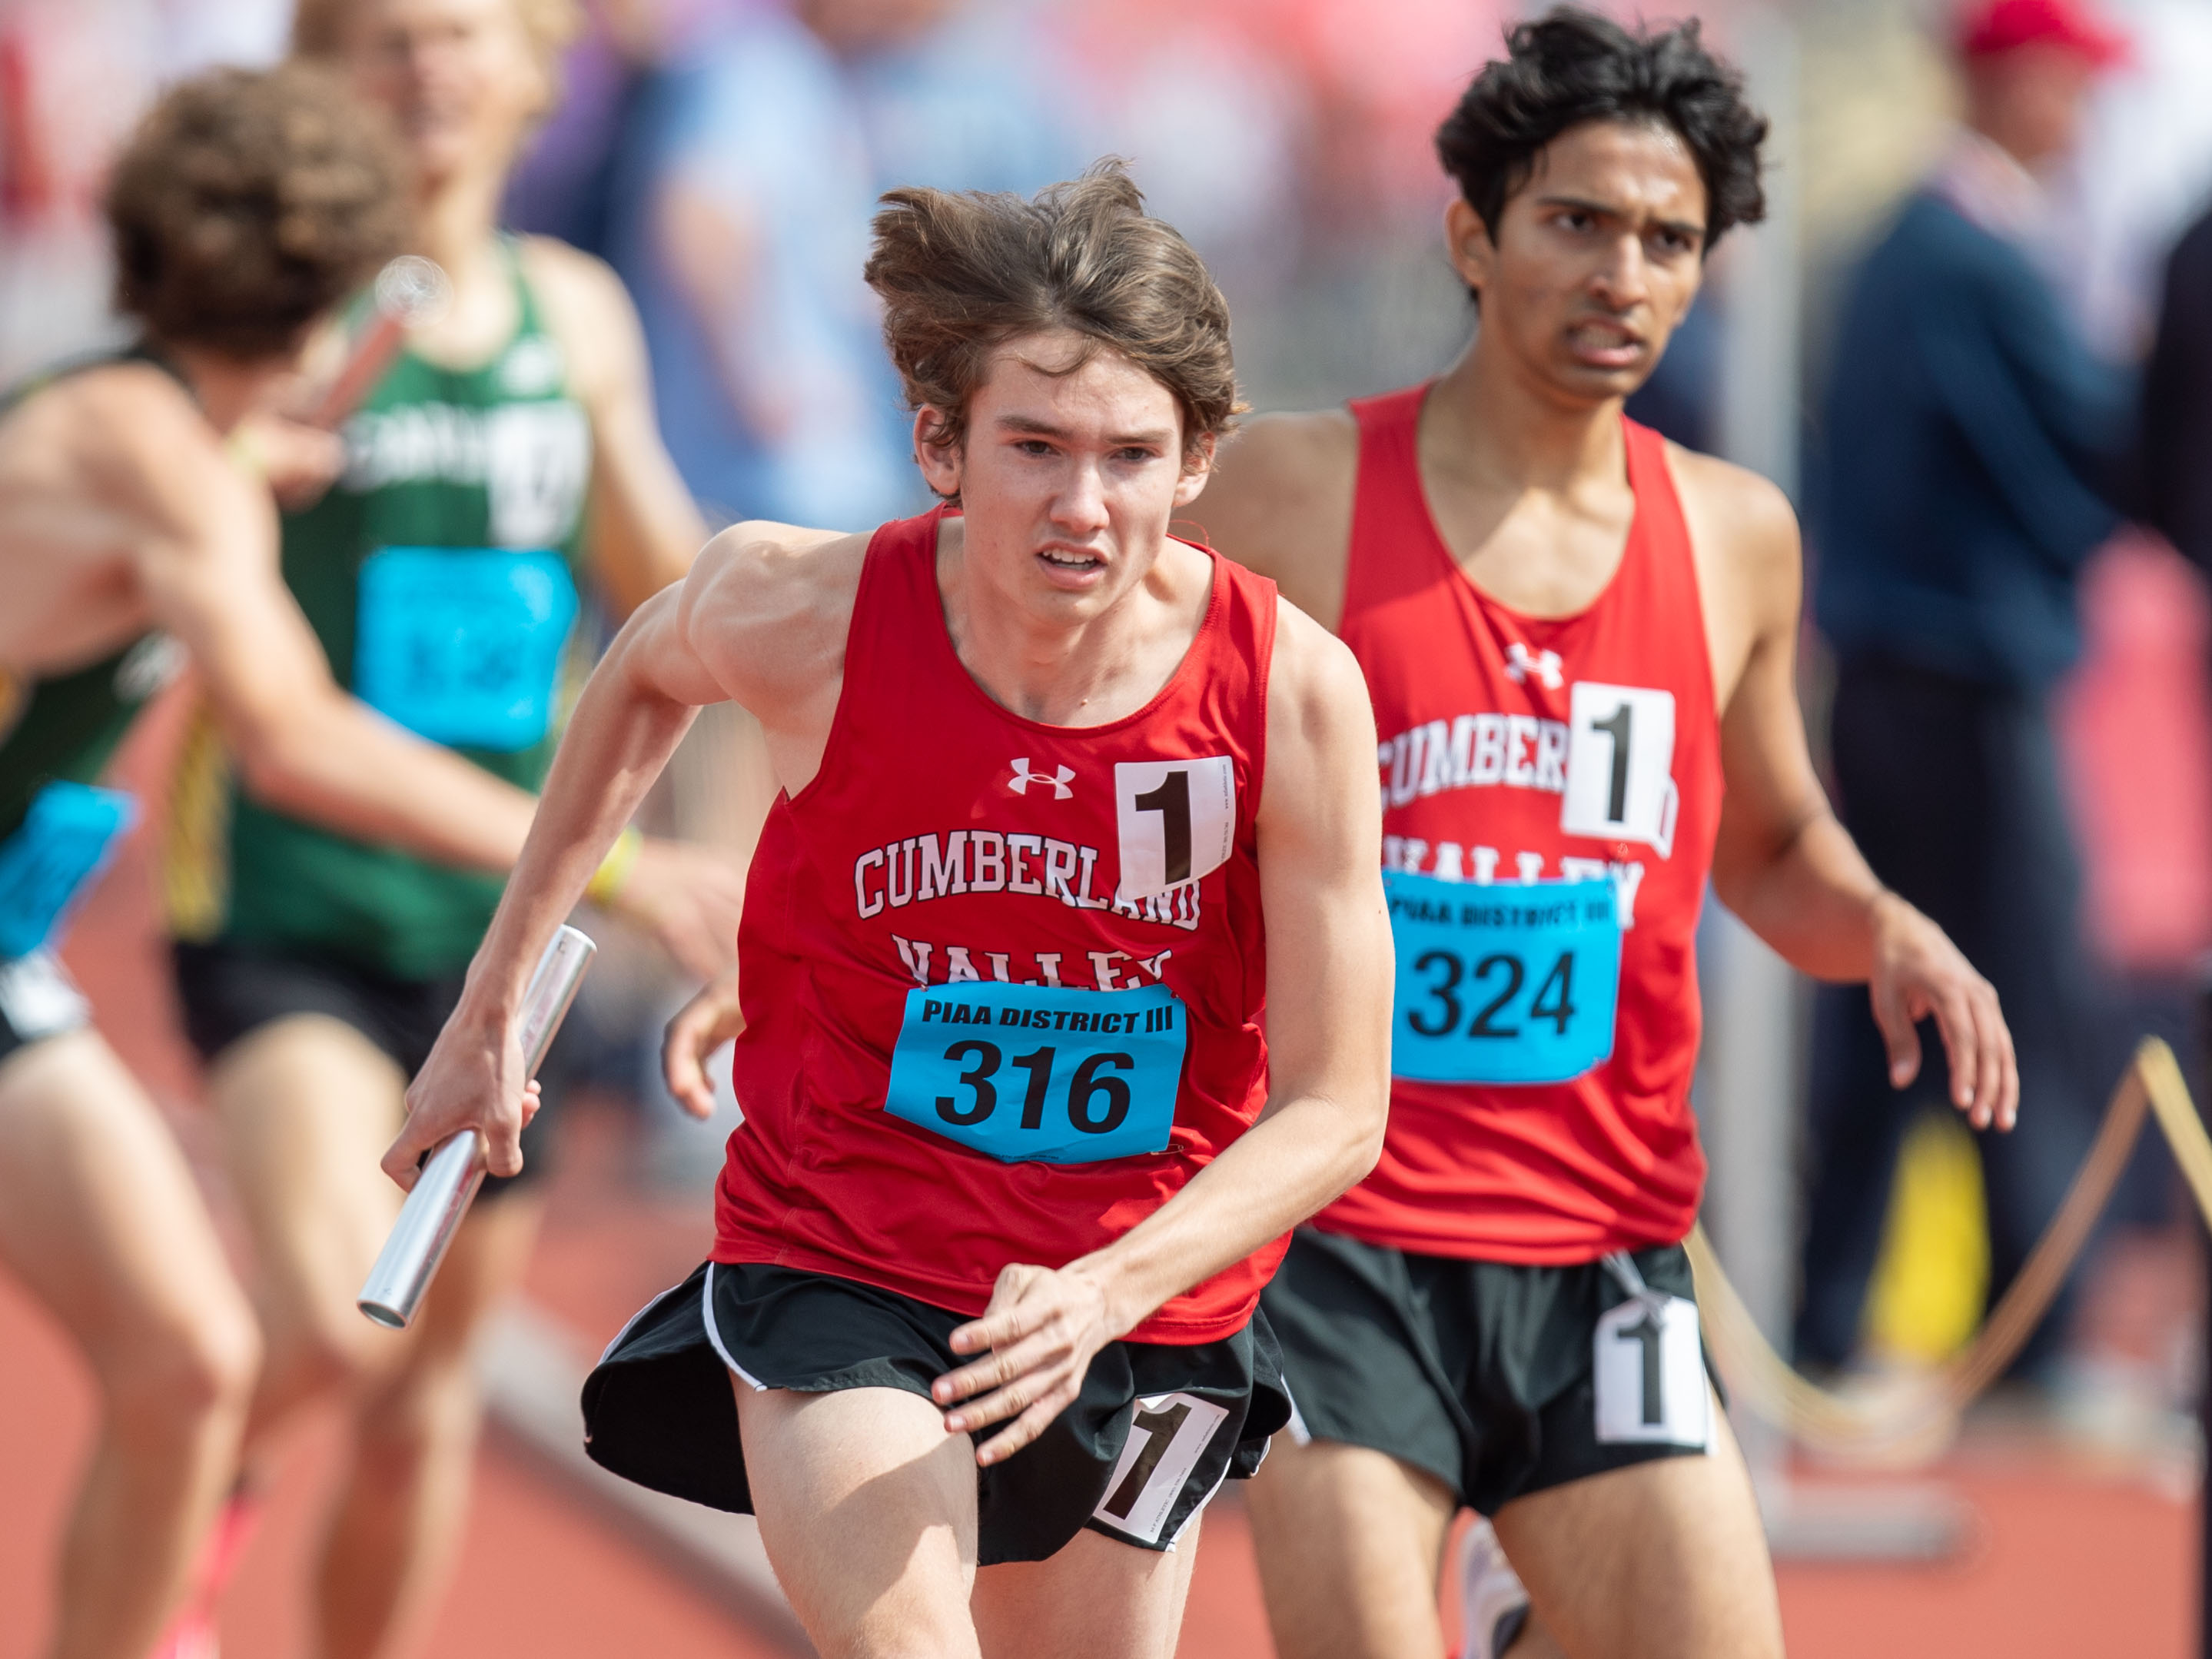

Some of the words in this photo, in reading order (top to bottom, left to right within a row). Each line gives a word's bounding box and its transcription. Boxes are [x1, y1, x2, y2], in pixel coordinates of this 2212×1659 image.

[1590, 703, 1632, 823] 1
[1134, 770, 1191, 886] 1
[922, 999, 991, 1025] PIAA
[999, 1007, 1140, 1034] DISTRICT
[1145, 1005, 1173, 1033] III
[1407, 949, 1576, 1039] 324
[935, 1039, 1134, 1134] 316
[1617, 1314, 1662, 1425] 1
[1102, 1401, 1192, 1521] 1
